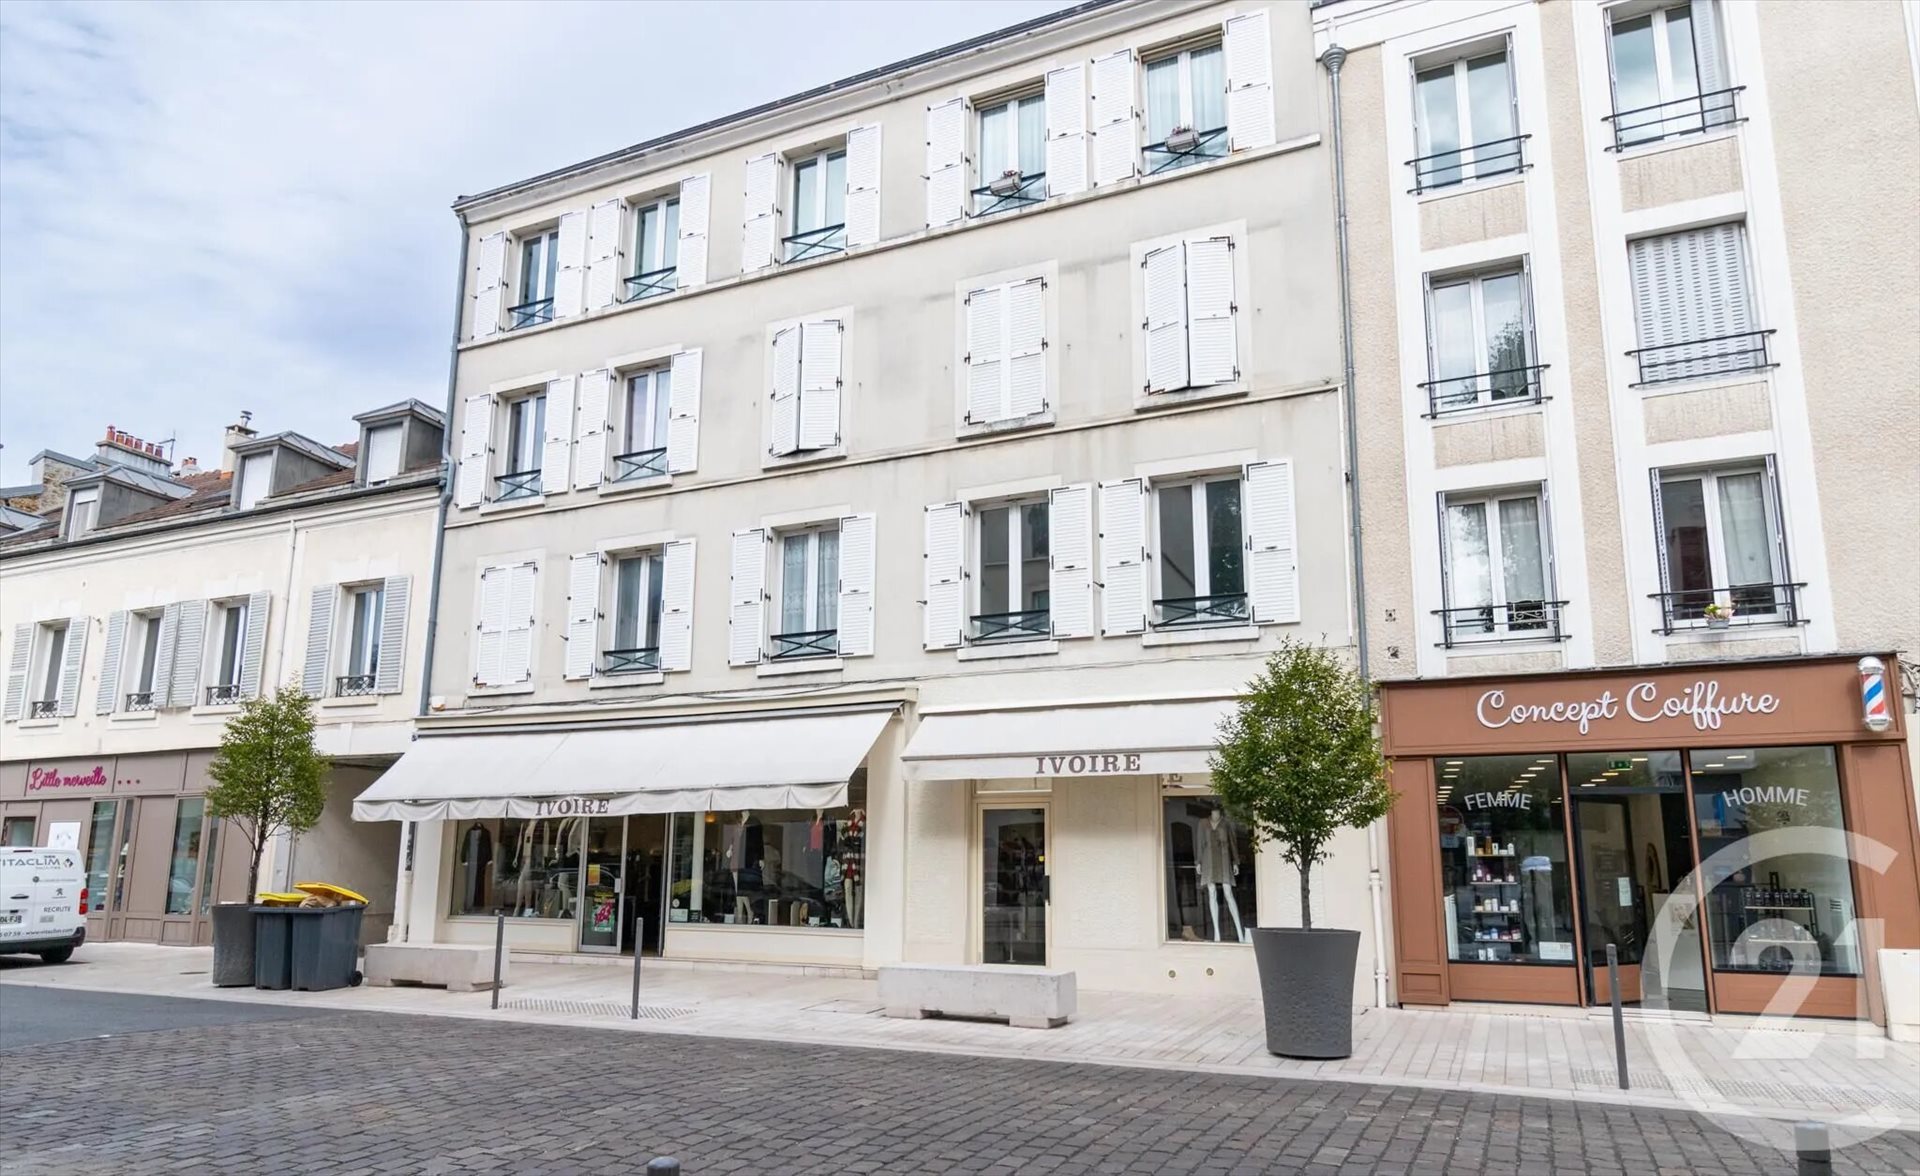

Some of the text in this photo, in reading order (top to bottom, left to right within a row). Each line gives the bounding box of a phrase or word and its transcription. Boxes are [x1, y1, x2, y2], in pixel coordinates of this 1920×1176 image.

[1476, 680, 1780, 735] Concept Coiffure
[1035, 753, 1142, 775] IVOIRE
[29, 767, 62, 790] Little
[535, 798, 610, 816] IVOIRE
[1464, 791, 1533, 811] FEMME
[1722, 786, 1810, 807] HOMME
[0, 858, 61, 867] ITACLIM
